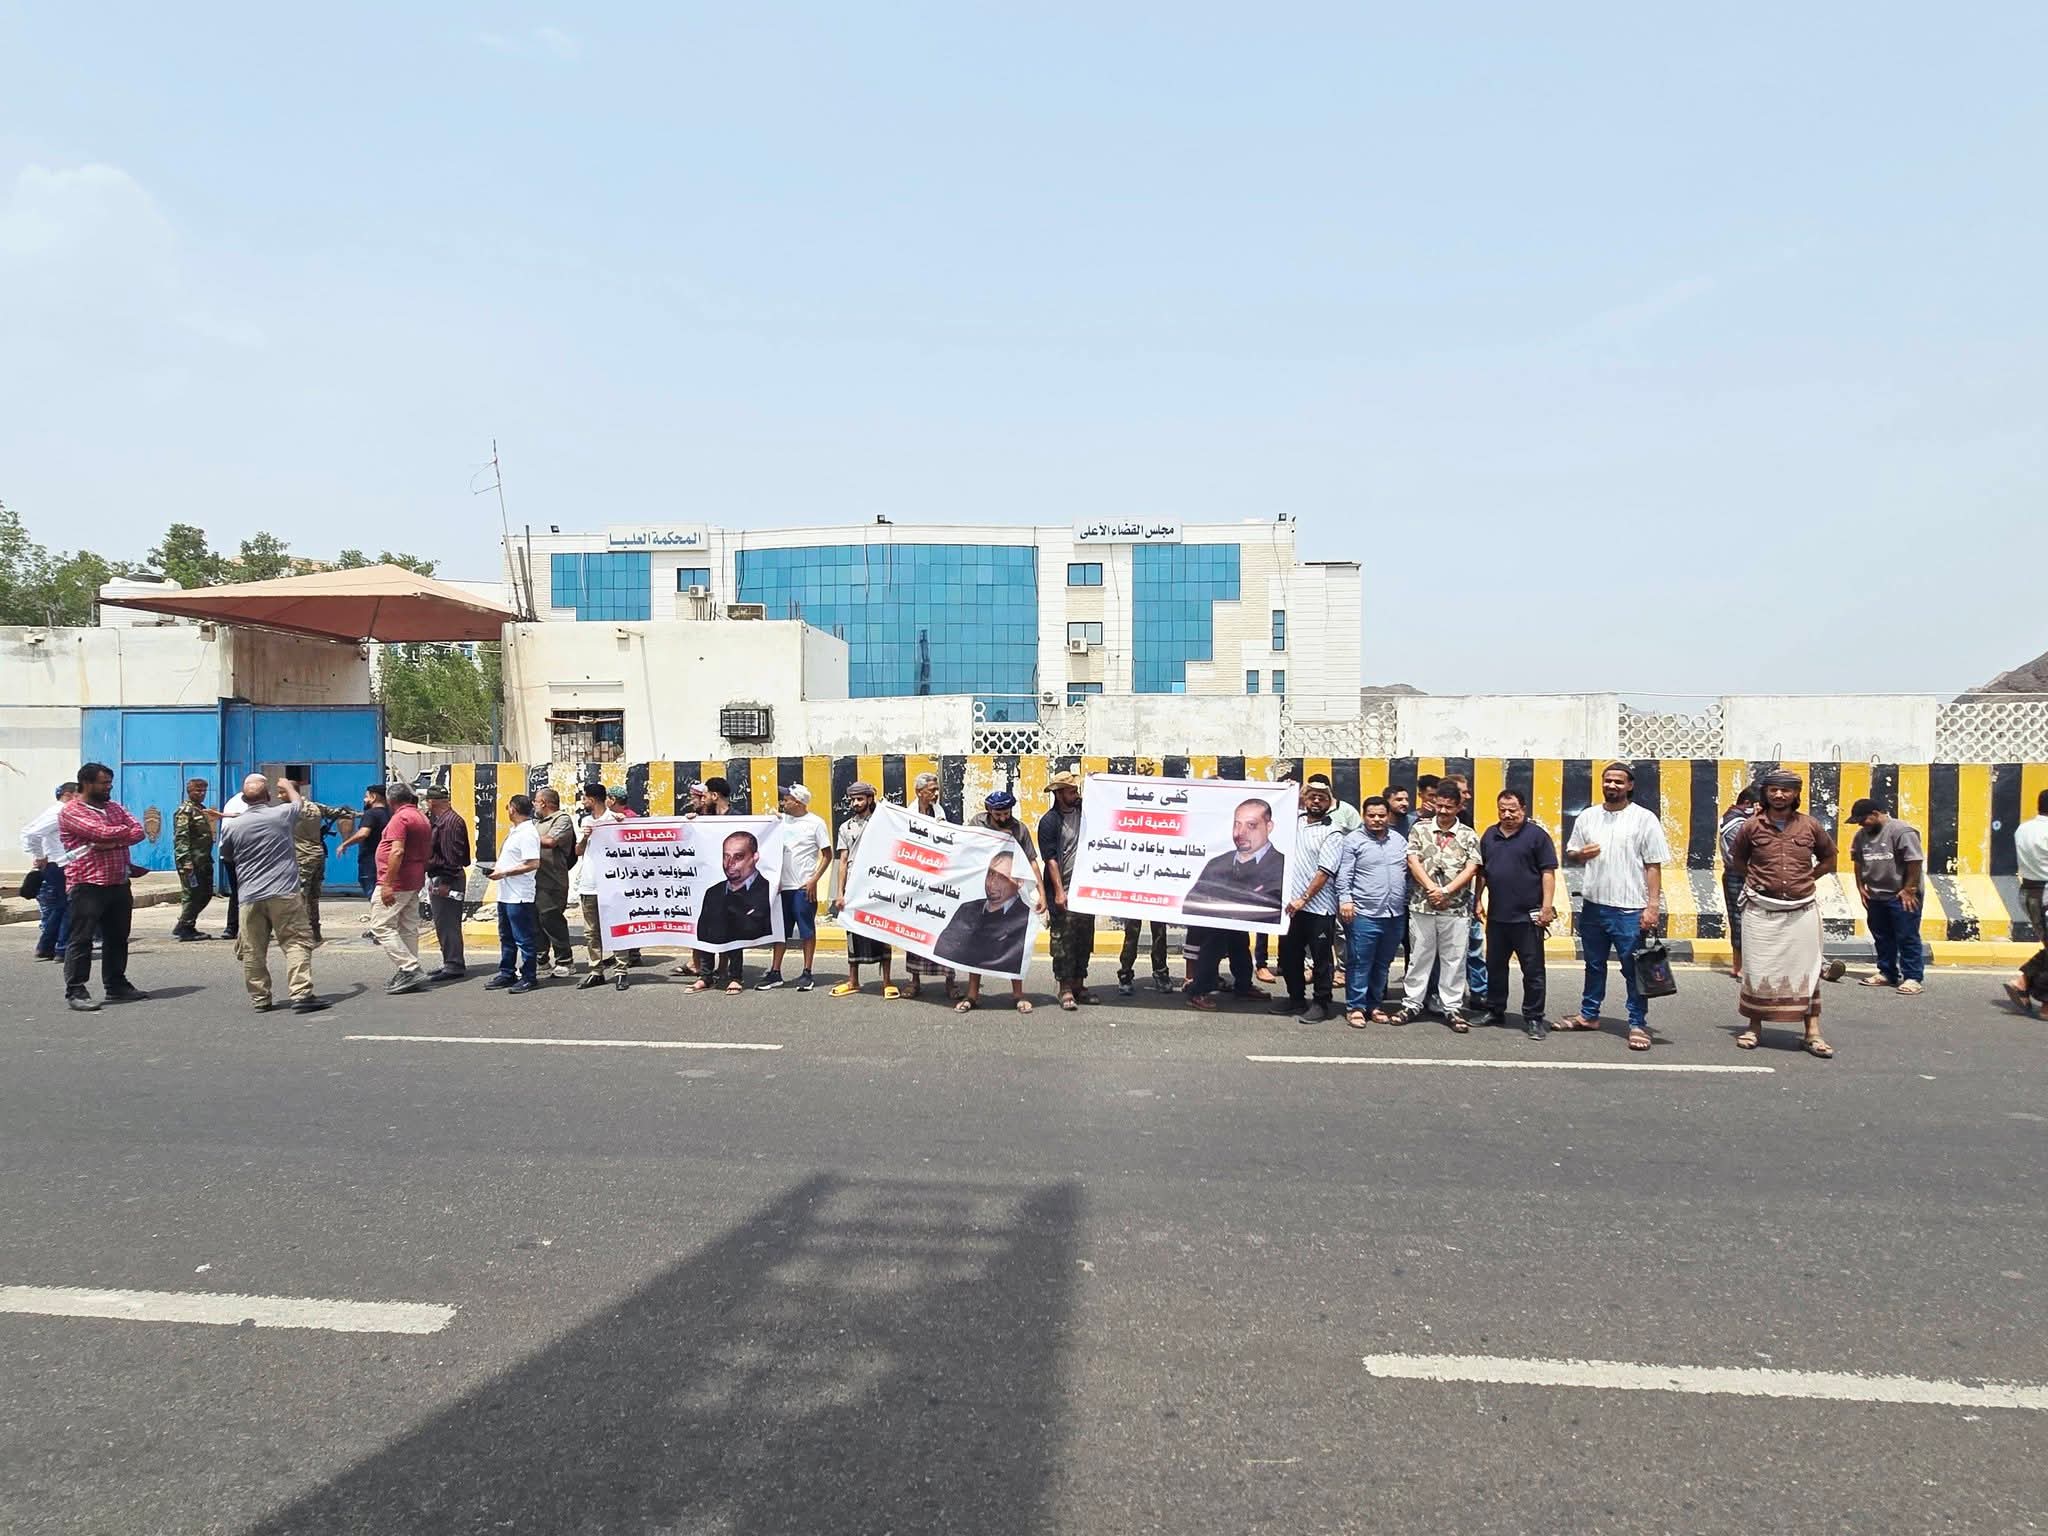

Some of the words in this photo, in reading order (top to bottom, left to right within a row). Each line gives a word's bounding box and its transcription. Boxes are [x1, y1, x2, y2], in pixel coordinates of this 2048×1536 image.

[1079, 522, 1111, 539] الأعلى
[1111, 523, 1144, 537] القضاء
[1144, 524, 1175, 539] مجلس
[608, 532, 651, 549] العليا
[652, 531, 702, 546] المحكمة
[1160, 789, 1189, 806] كفى
[1145, 816, 1181, 831] بقضية
[645, 830, 677, 841] بقضية
[1087, 836, 1127, 851] المحكوم
[1169, 844, 1206, 858] نطالب
[604, 846, 636, 858] العامة
[637, 846, 670, 860] النيابة
[672, 846, 696, 859] نحمل
[604, 866, 639, 880] قرارات
[641, 868, 655, 879] عن
[867, 864, 900, 881] المحكوم
[1092, 861, 1130, 874] السجن
[1154, 867, 1192, 881] عليهم
[623, 886, 659, 900] وهروب
[868, 888, 896, 904] السجن
[928, 883, 961, 900] نطالب
[628, 905, 660, 921] عليهم
[663, 904, 692, 919] المحكوم
[915, 903, 947, 919] عليهم
